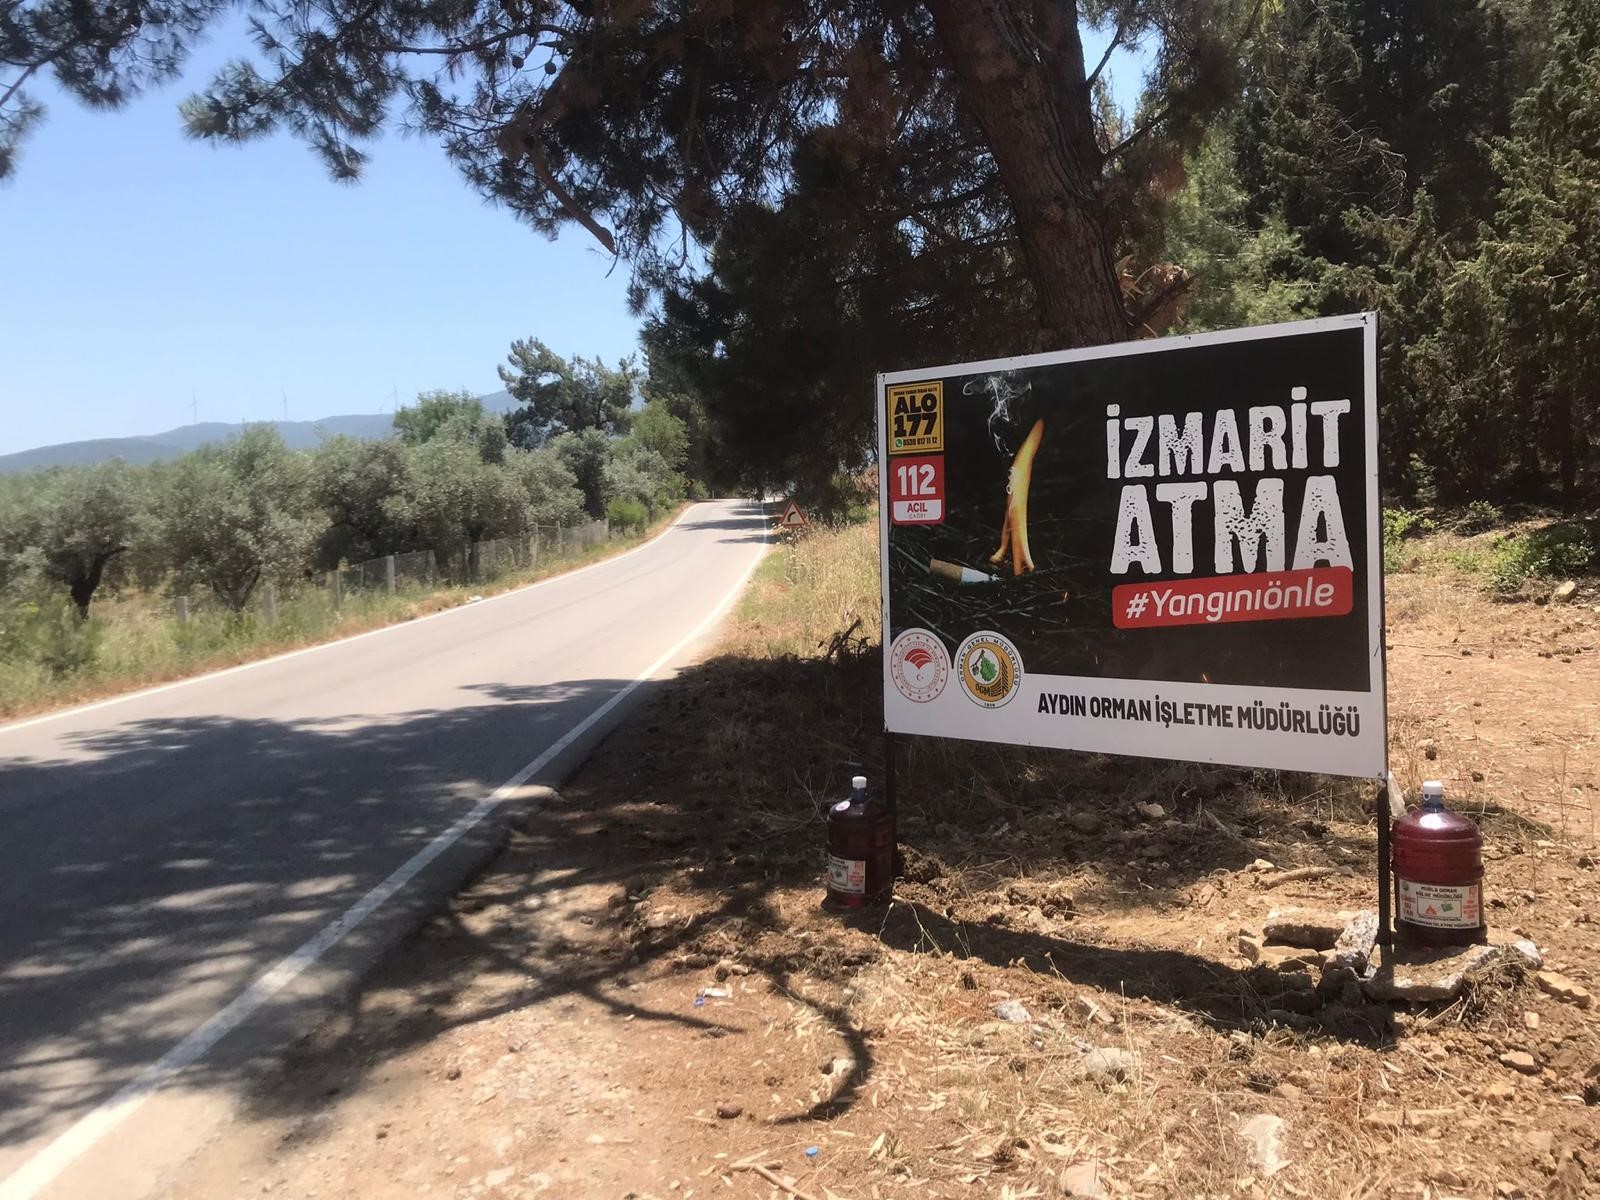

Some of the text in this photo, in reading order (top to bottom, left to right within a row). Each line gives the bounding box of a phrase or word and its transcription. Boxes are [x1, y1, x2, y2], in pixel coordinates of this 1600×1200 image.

[894, 393, 937, 415] ALO
[894, 412, 937, 437] 177
[1106, 386, 1351, 479] İZMARİT
[897, 463, 936, 496] 112
[907, 502, 928, 513] ACİL
[1109, 474, 1354, 574] ATMA
[1126, 576, 1335, 622] #Yangınıönle
[1037, 692, 1360, 737] AYDIN ORMAN İŞLETME MÜDÜRLÜĞÜ
